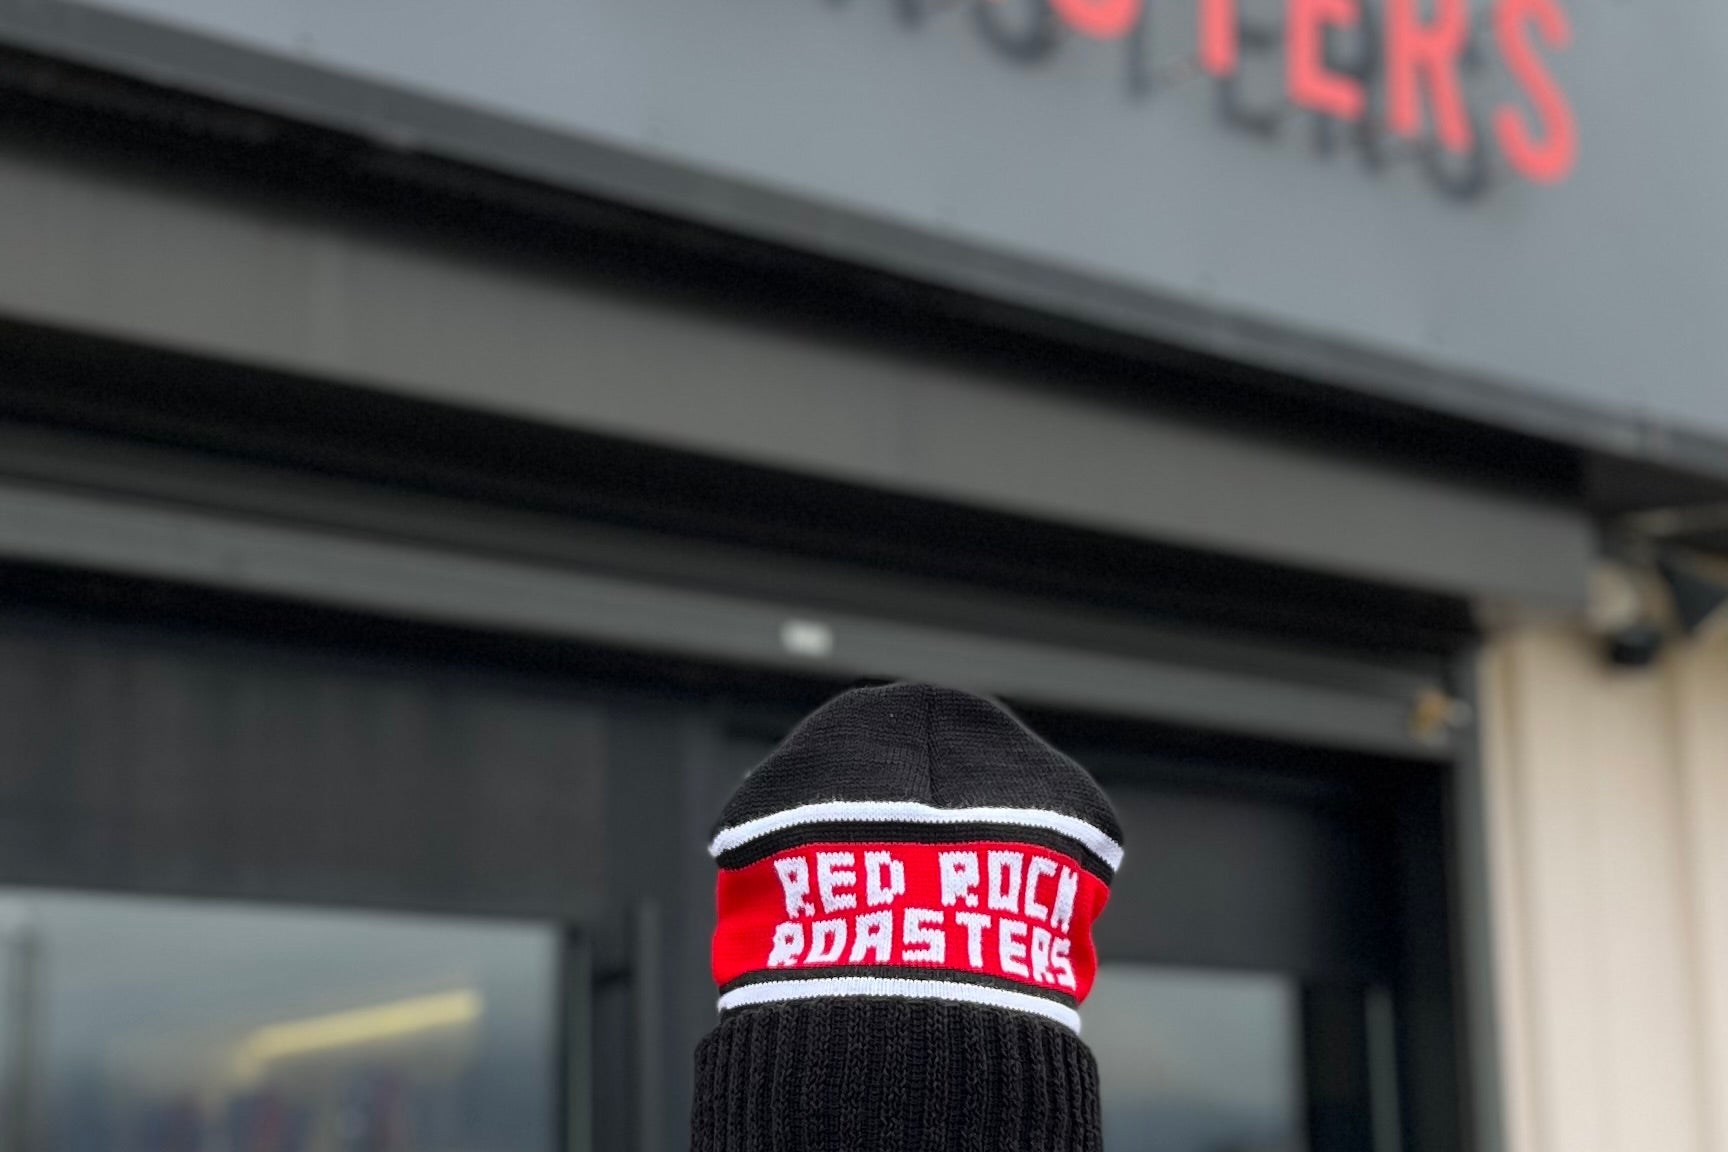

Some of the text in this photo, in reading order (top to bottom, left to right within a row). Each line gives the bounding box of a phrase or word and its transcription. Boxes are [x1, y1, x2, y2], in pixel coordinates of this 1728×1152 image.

[774, 849, 1080, 933] RED ROCK
[767, 907, 1077, 992] ROASTERS
